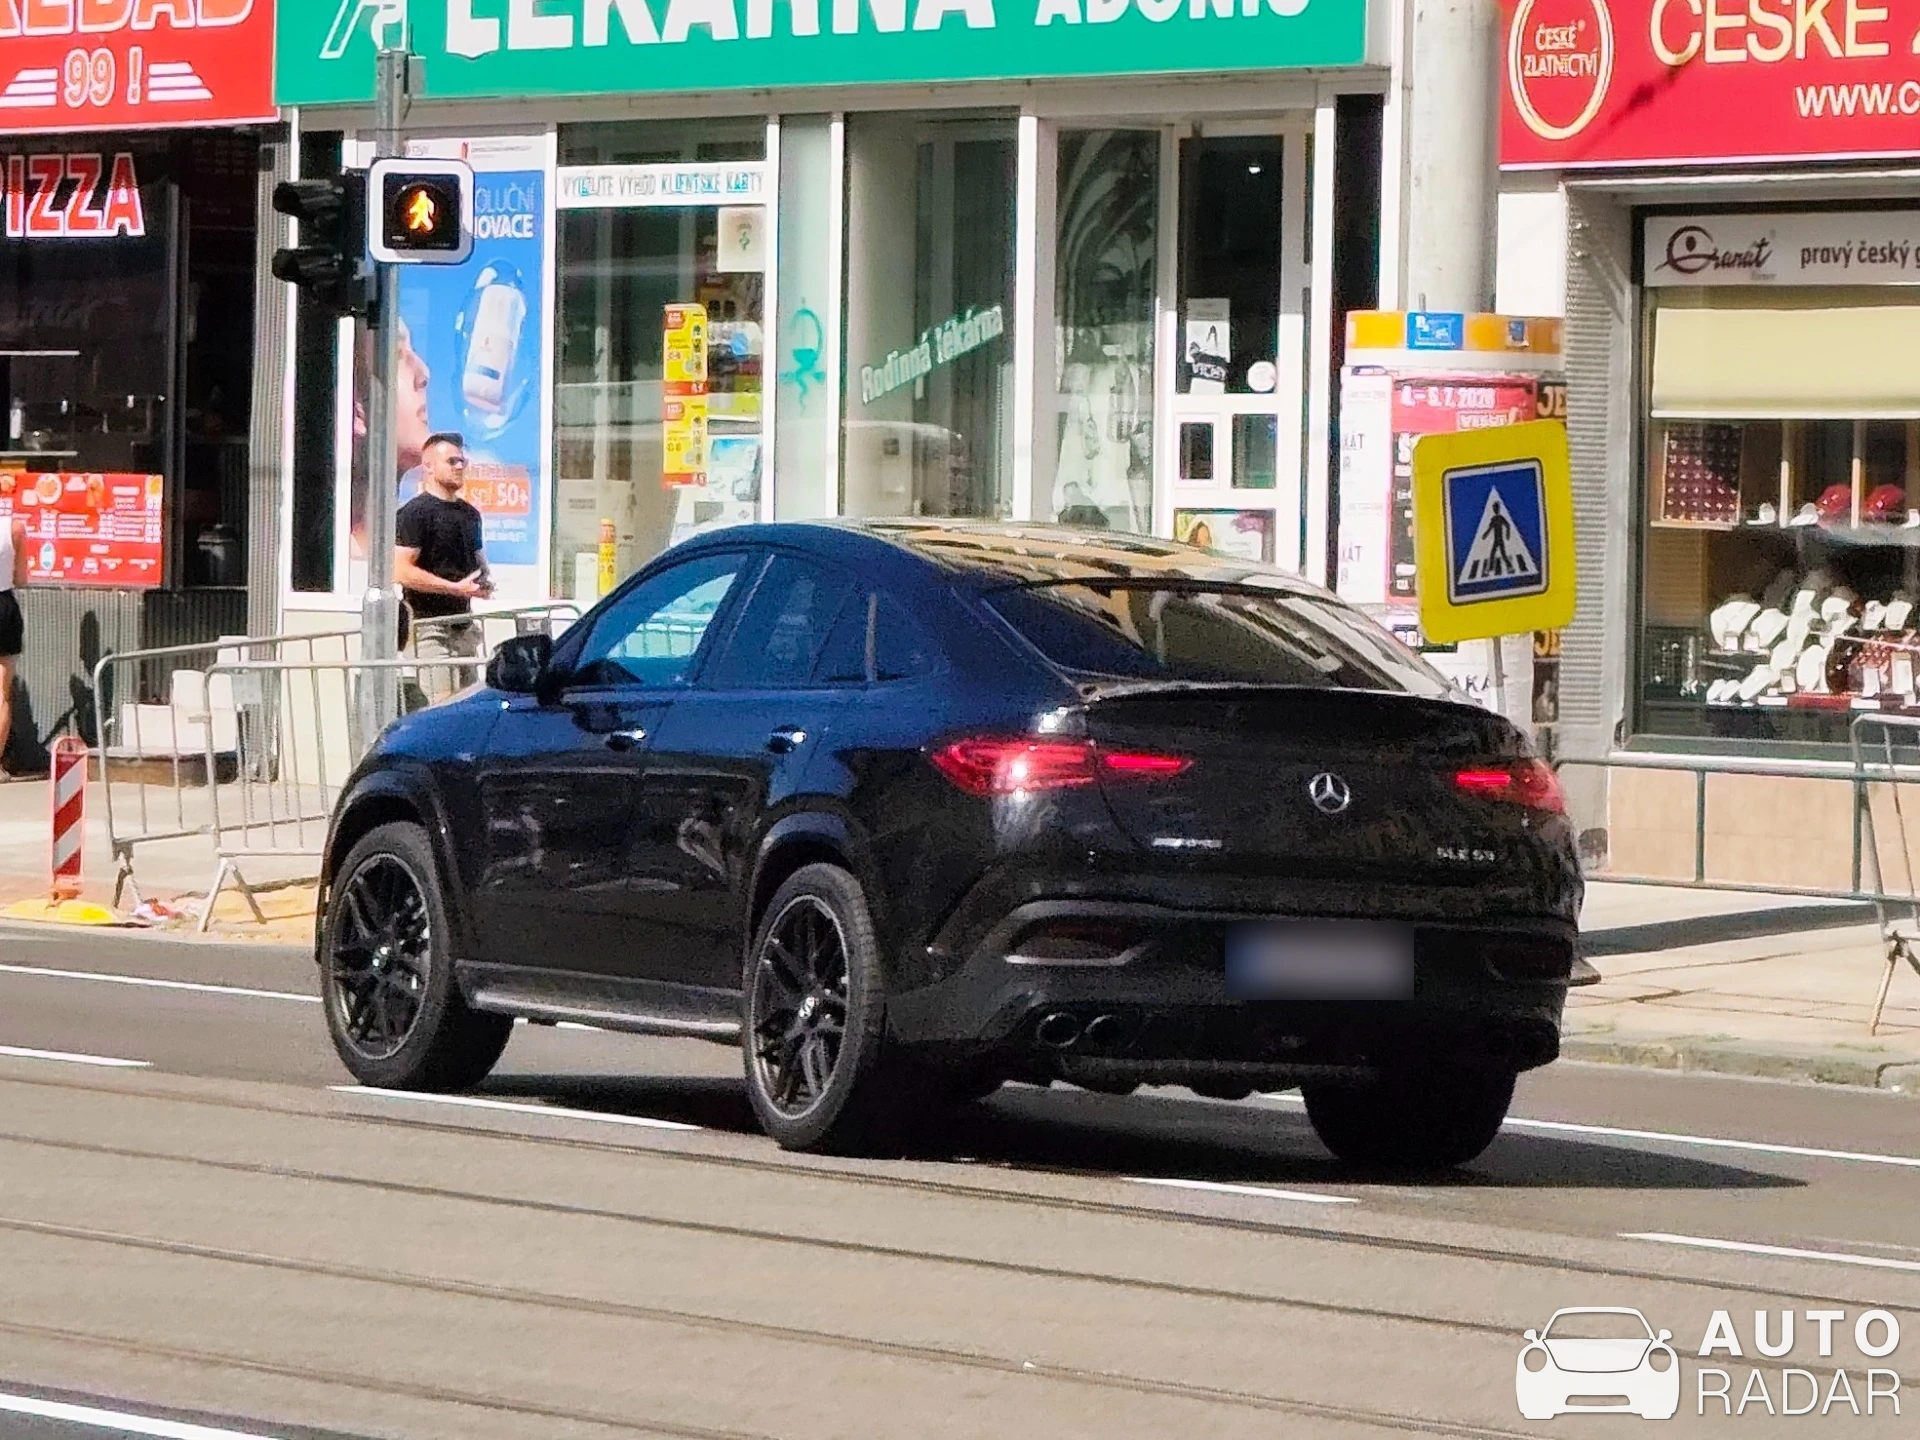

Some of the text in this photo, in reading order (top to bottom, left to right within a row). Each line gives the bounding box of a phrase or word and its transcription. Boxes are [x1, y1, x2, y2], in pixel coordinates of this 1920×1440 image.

[1536, 20, 1577, 51] ČESKÉ
[64, 47, 116, 108] 99
[0, 153, 146, 237] IZZA
[1801, 241, 1852, 269] pravý
[1857, 240, 1910, 269] český
